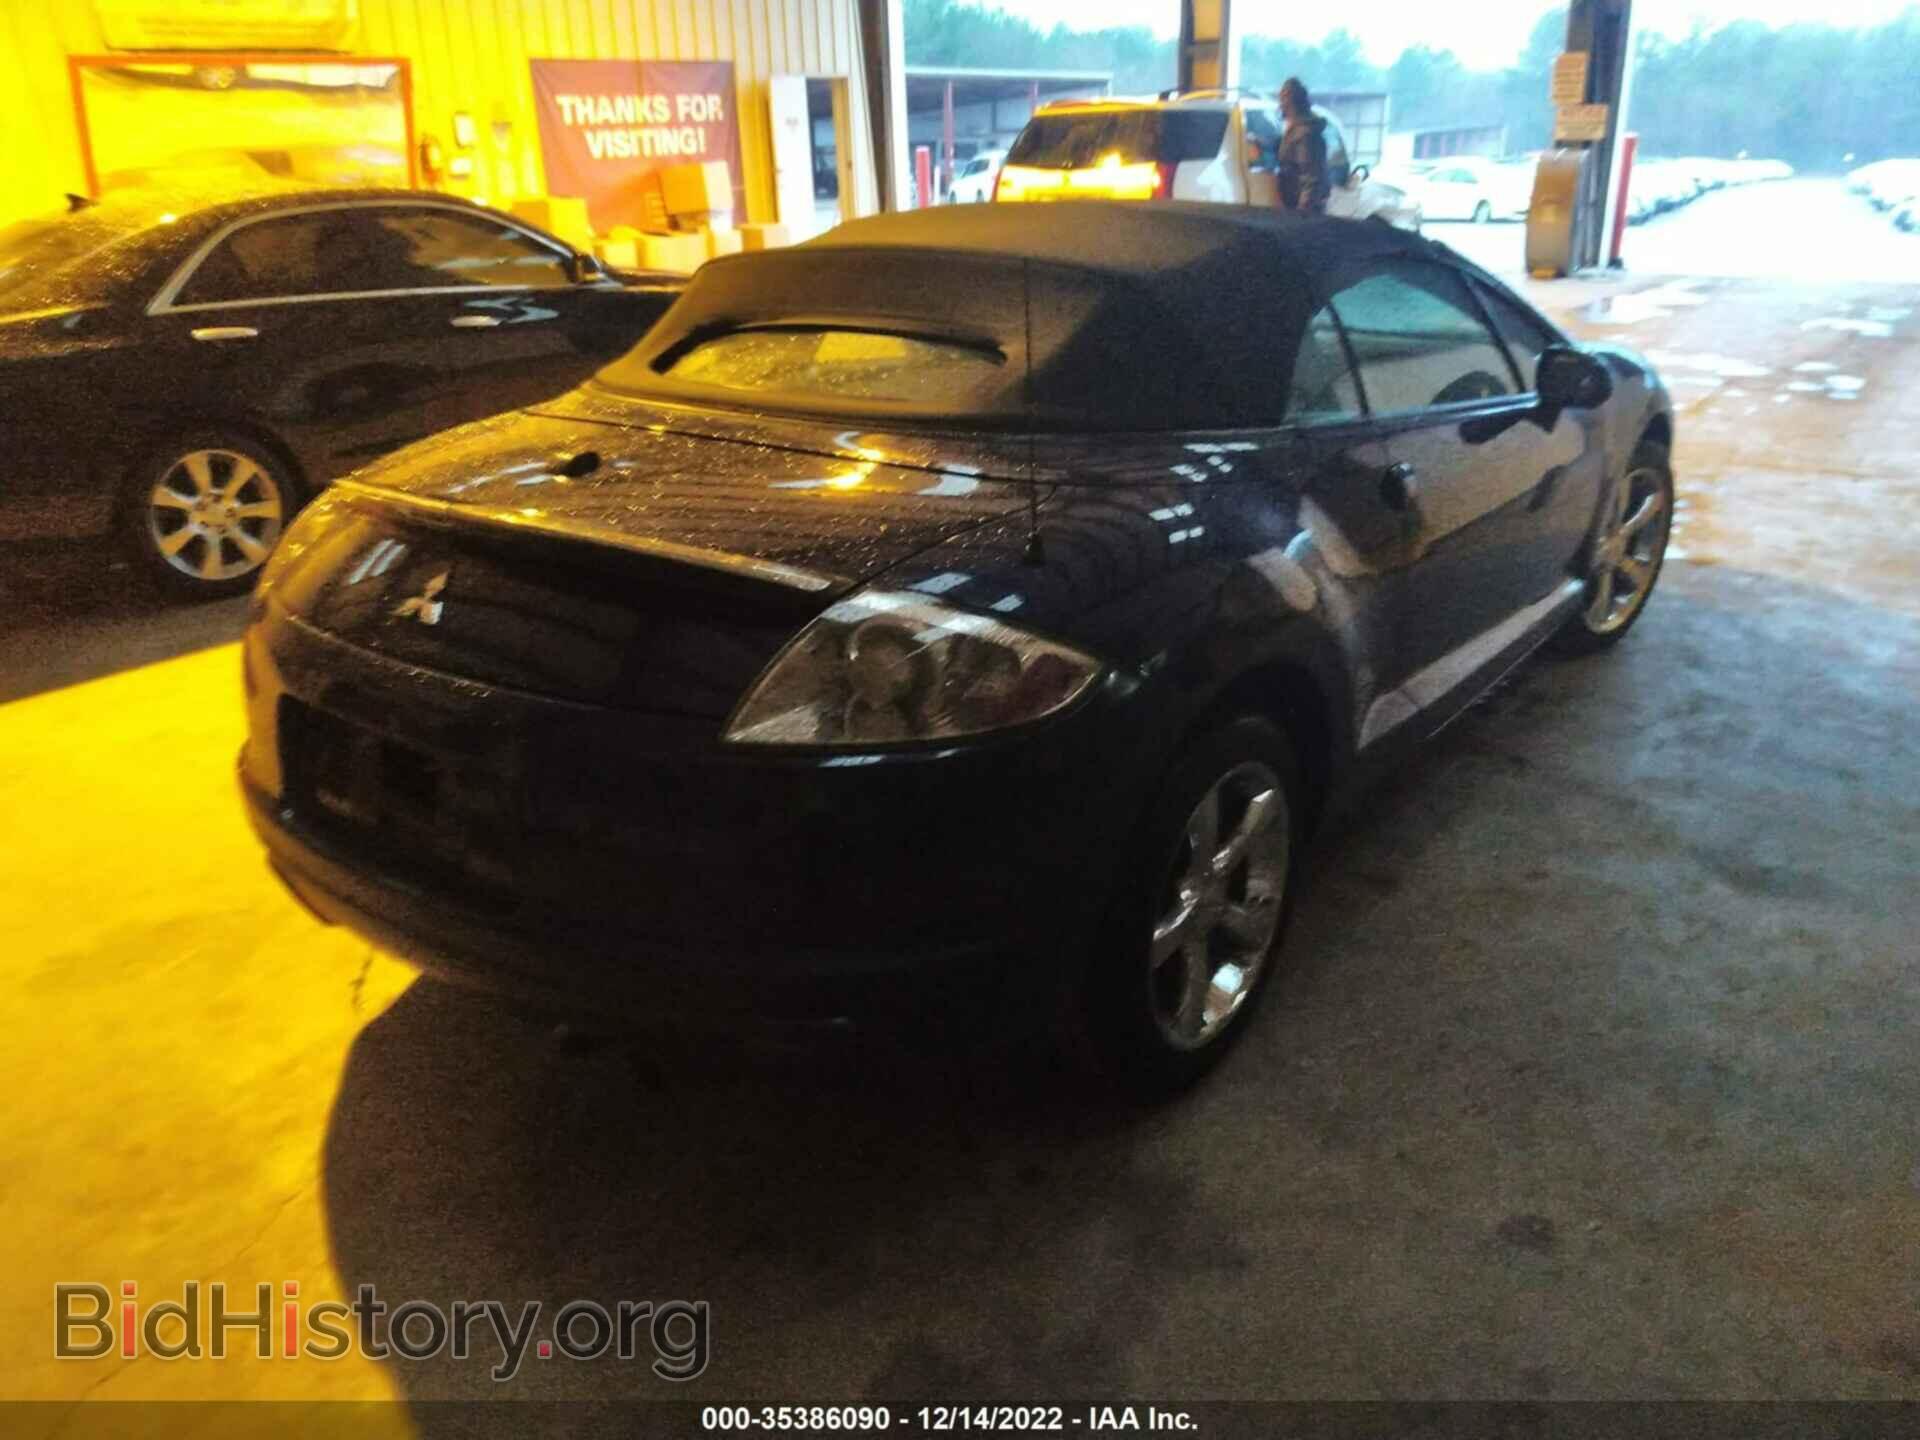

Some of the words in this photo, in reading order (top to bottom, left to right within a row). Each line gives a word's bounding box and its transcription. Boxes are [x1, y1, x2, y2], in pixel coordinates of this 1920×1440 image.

[555, 94, 671, 126] THANKS
[675, 94, 724, 122] FOR
[584, 127, 706, 159] VISITING!
